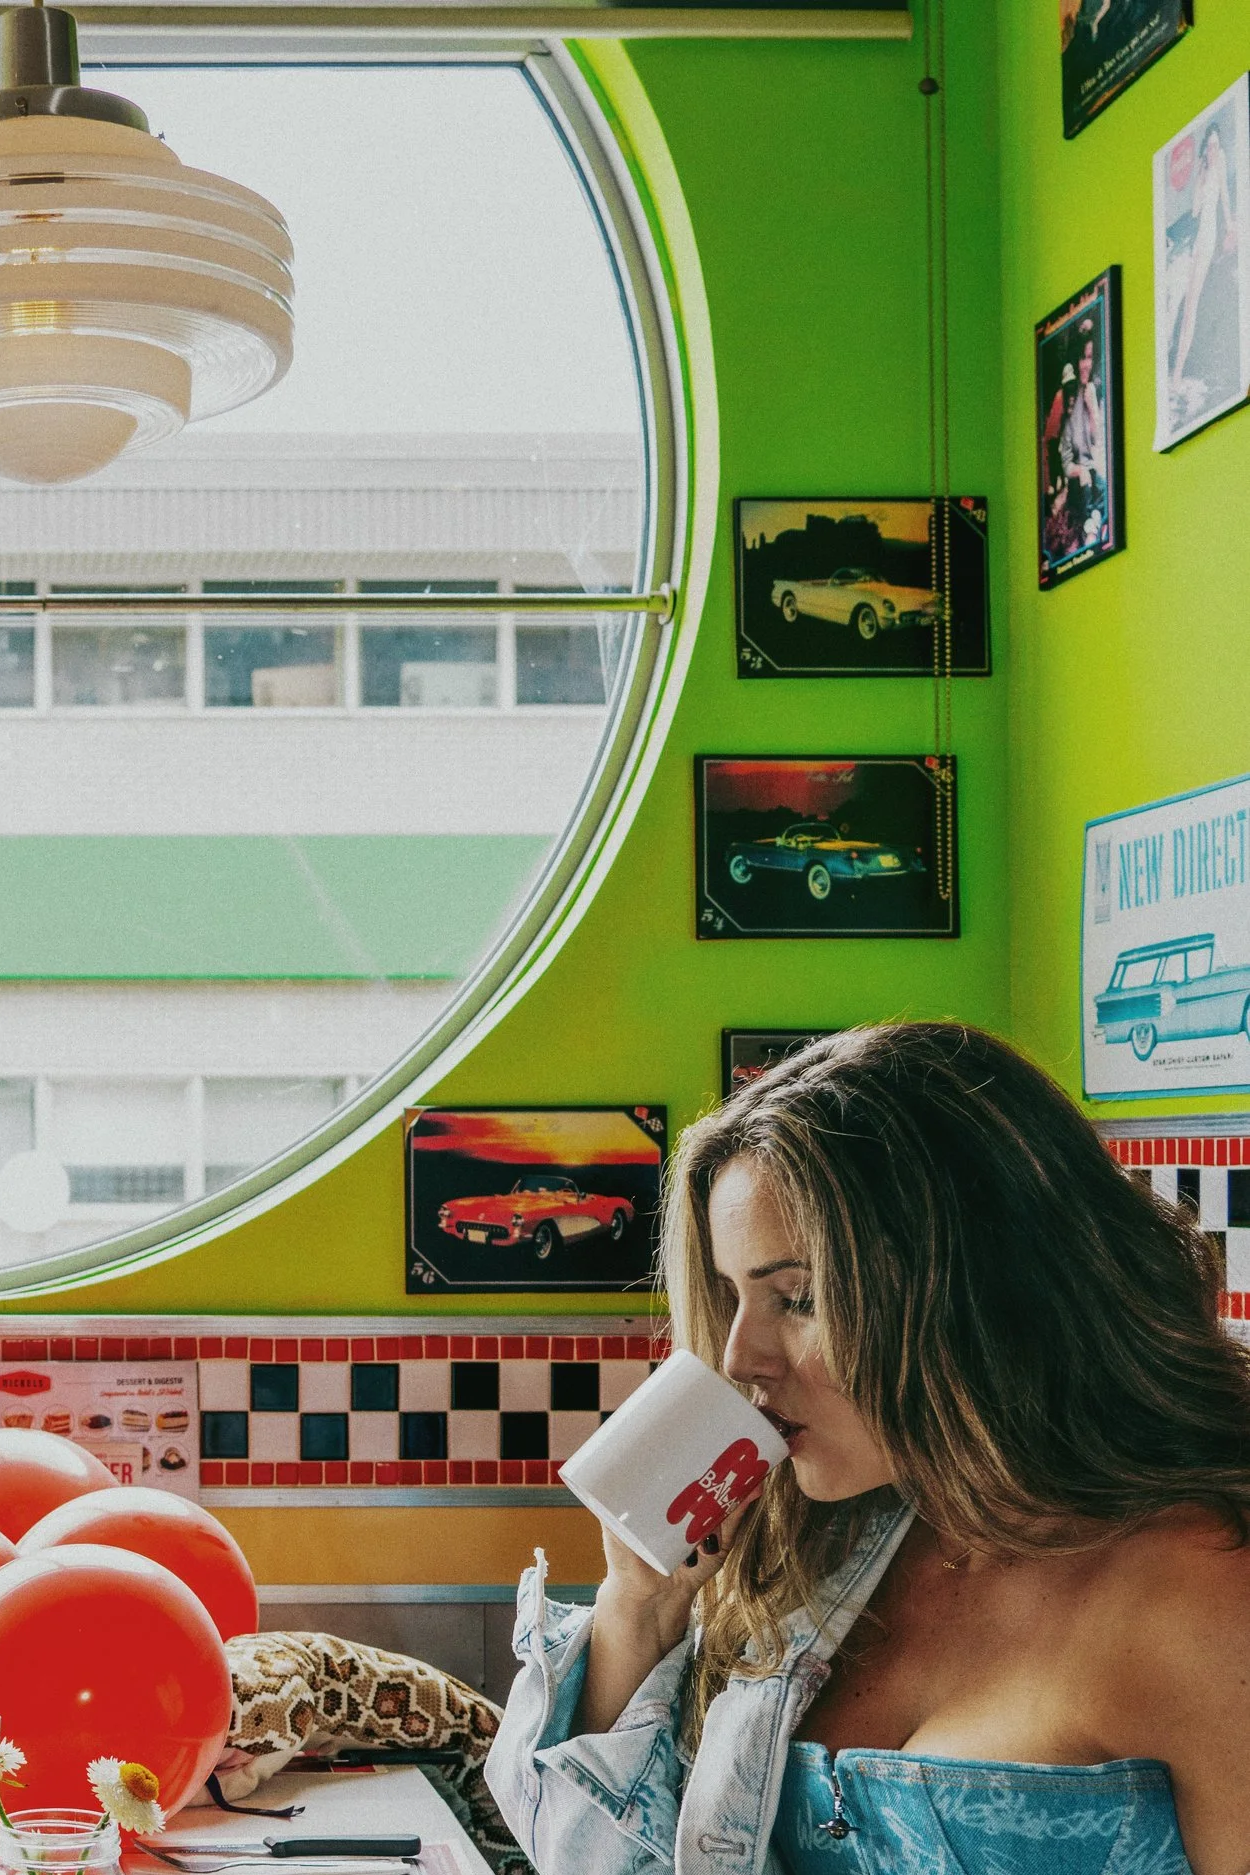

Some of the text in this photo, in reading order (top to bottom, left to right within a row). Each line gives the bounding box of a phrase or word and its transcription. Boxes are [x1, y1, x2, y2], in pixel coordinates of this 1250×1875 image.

[1119, 832, 1164, 911] NEW
[701, 909, 726, 931] 54
[411, 1262, 435, 1284] 56
[116, 1377, 146, 1387] DESSERT
[154, 1376, 184, 1386] DIGESTIF
